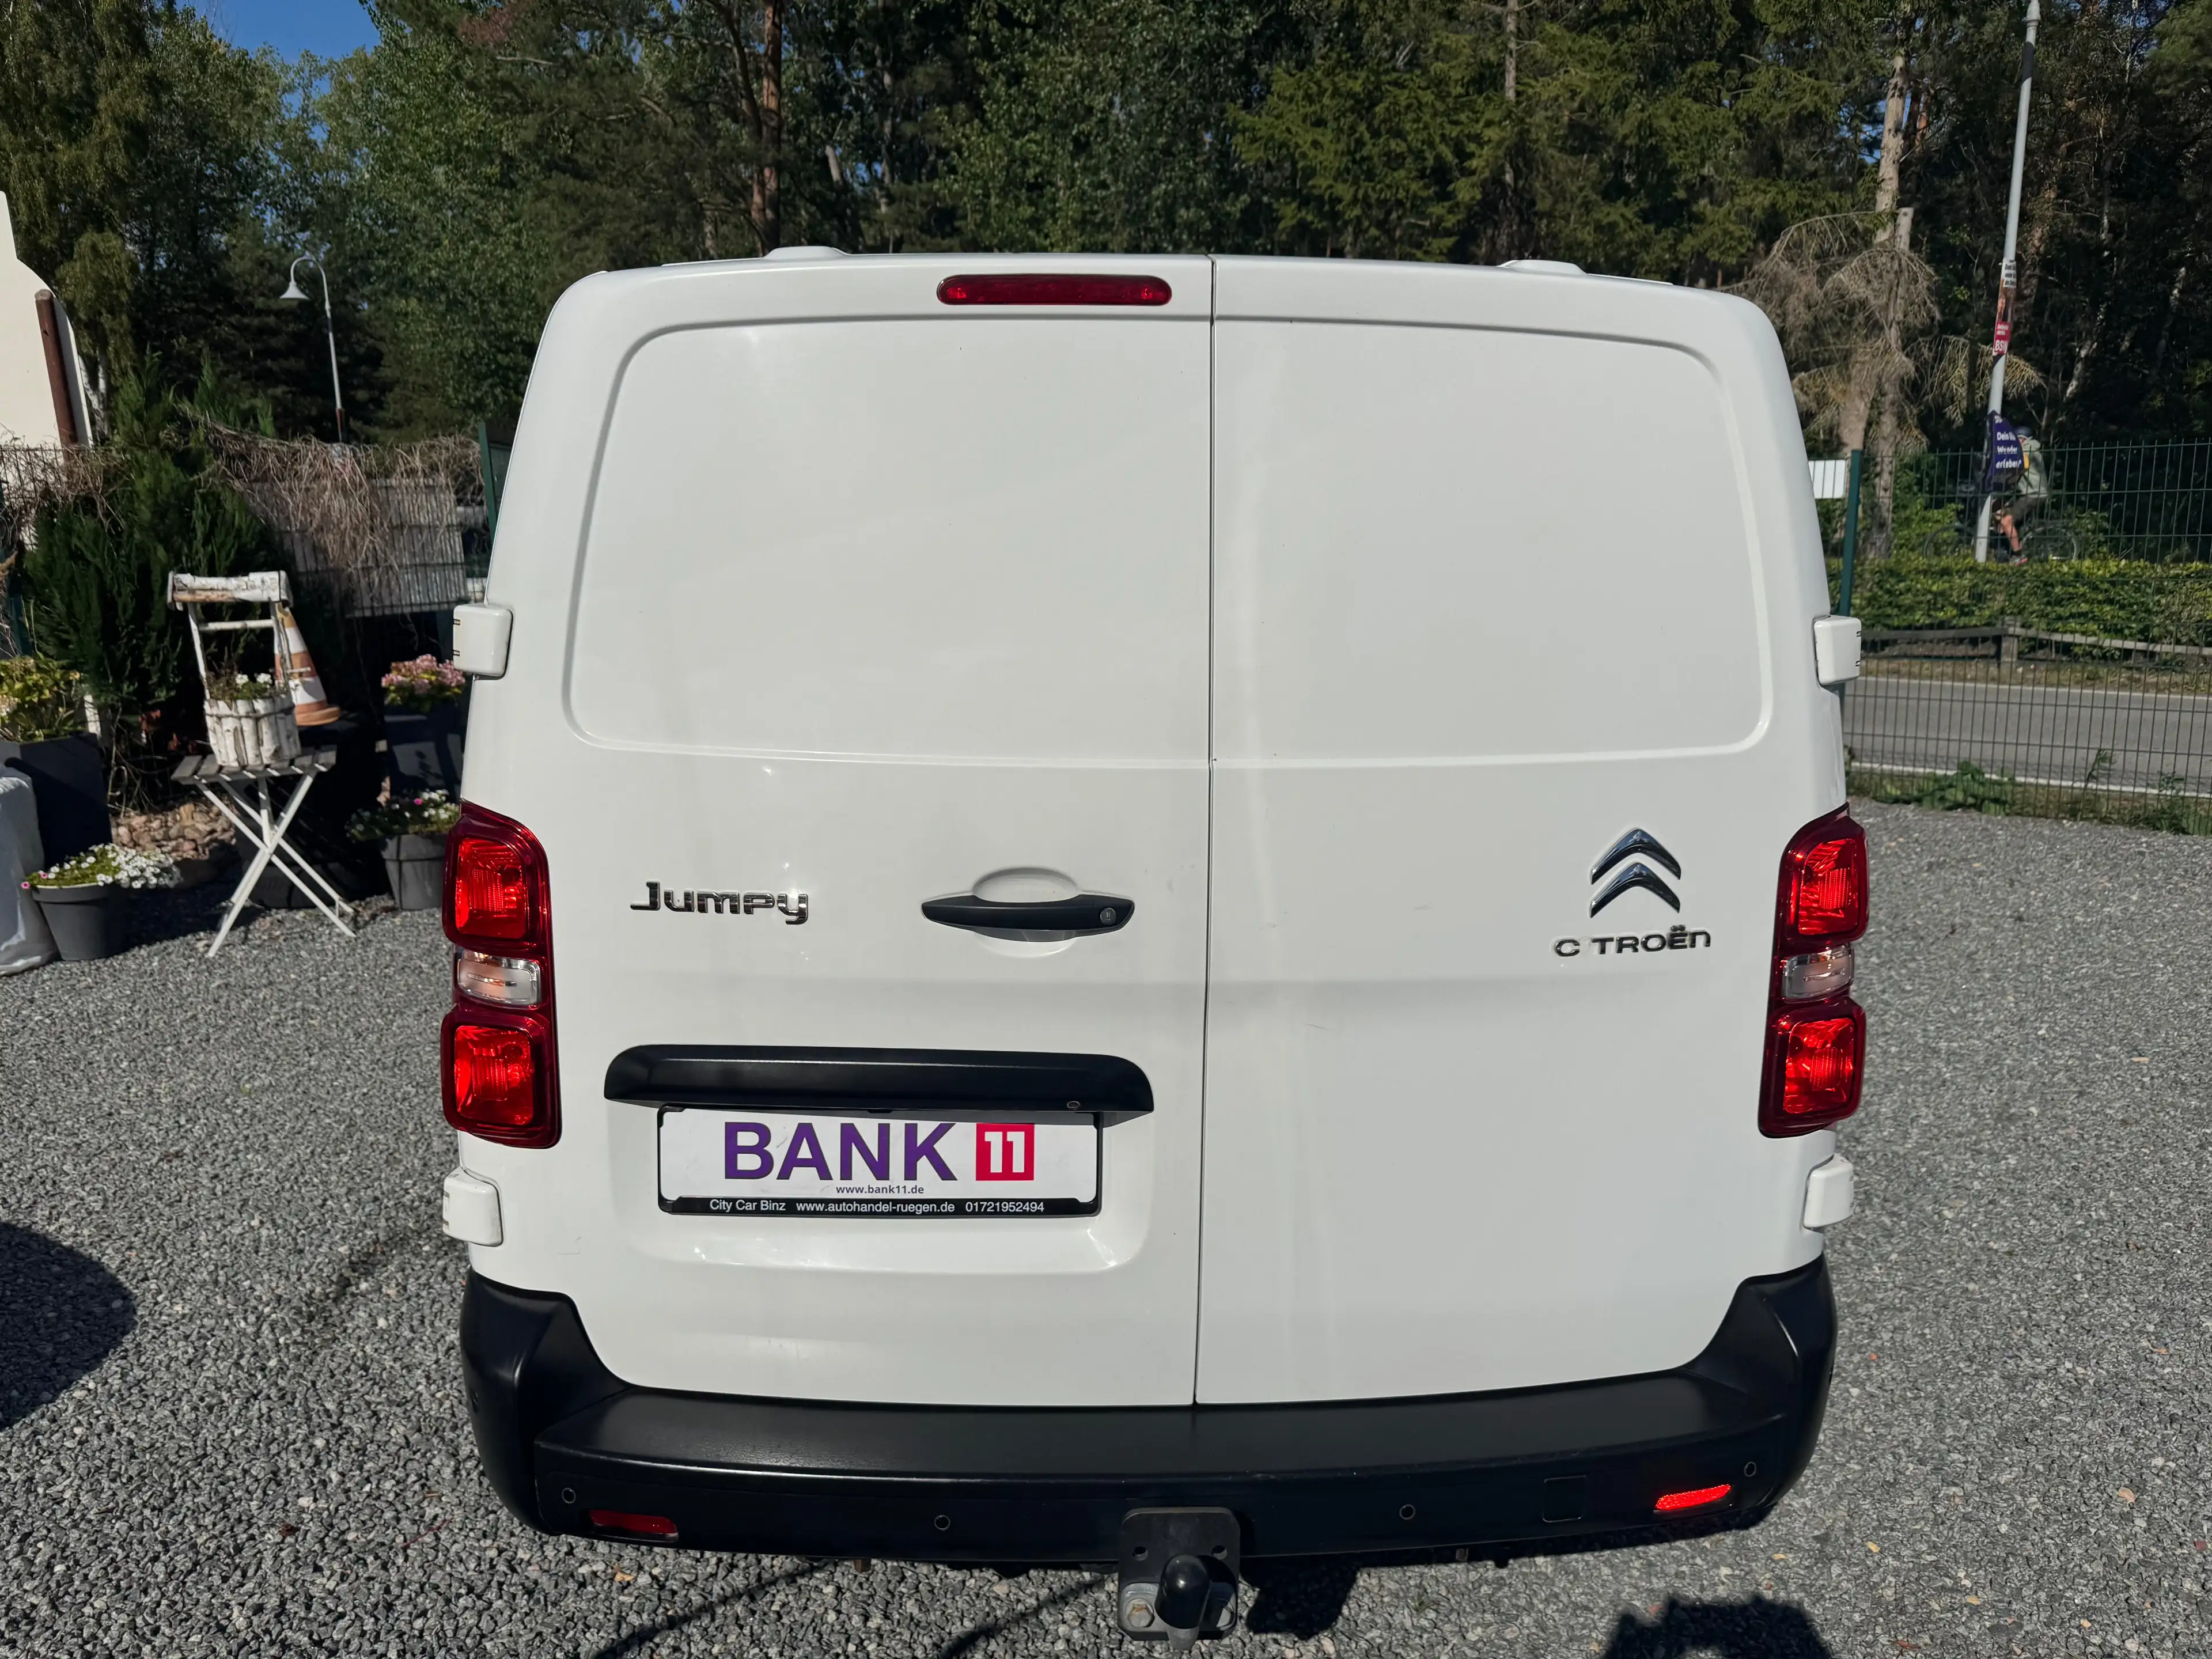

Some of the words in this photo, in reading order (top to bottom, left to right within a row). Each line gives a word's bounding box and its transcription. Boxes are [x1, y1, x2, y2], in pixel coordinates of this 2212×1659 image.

[630, 881, 809, 925] Jumpy
[725, 1122, 958, 1181] BANK
[984, 1131, 1025, 1173] 11
[836, 1184, 924, 1194] www.bank11.de
[710, 1200, 732, 1213] City
[735, 1200, 757, 1211] Car
[760, 1200, 786, 1211] Binz
[796, 1201, 955, 1214] www.autohandel-ruegen.de
[965, 1202, 1044, 1213] 01721952494
